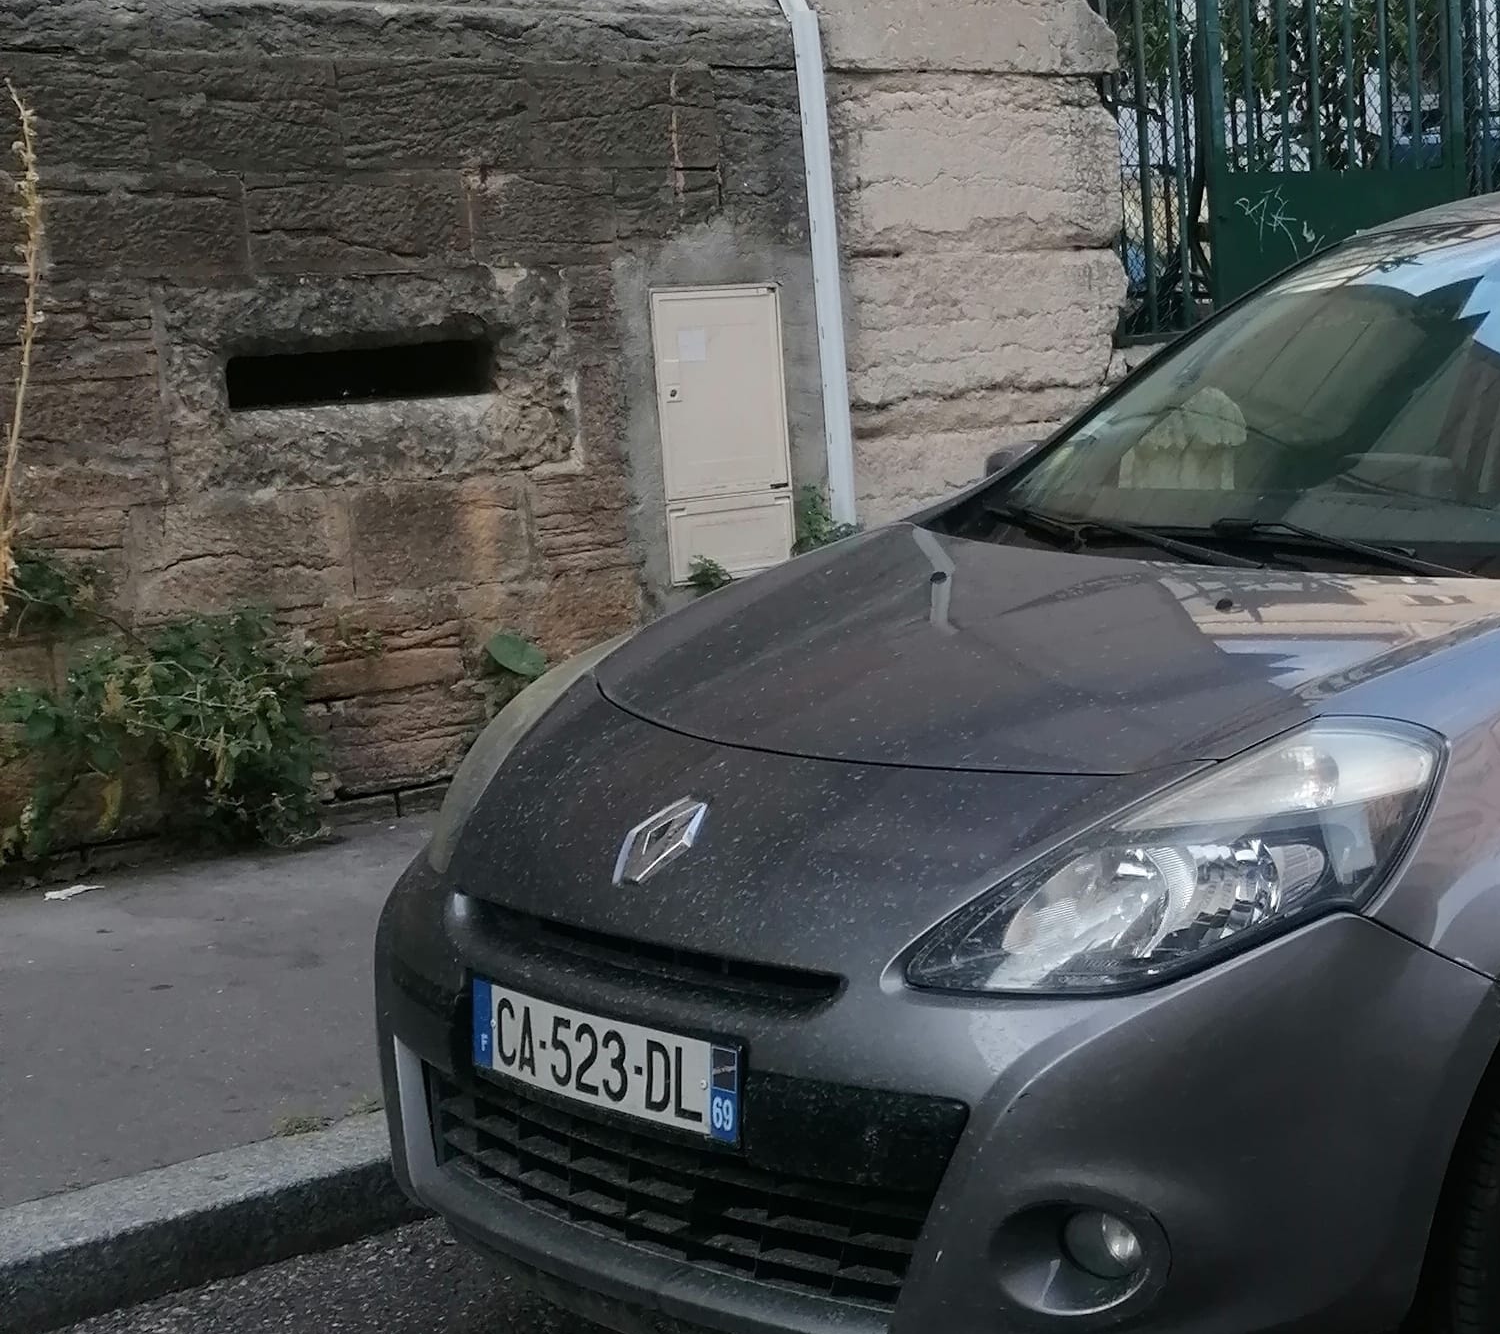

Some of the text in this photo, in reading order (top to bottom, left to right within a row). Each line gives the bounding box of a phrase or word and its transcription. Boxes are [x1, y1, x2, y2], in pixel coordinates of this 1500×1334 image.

[480, 1033, 489, 1052] F
[496, 998, 703, 1123] CA-523-DL
[712, 1097, 734, 1132] 69
